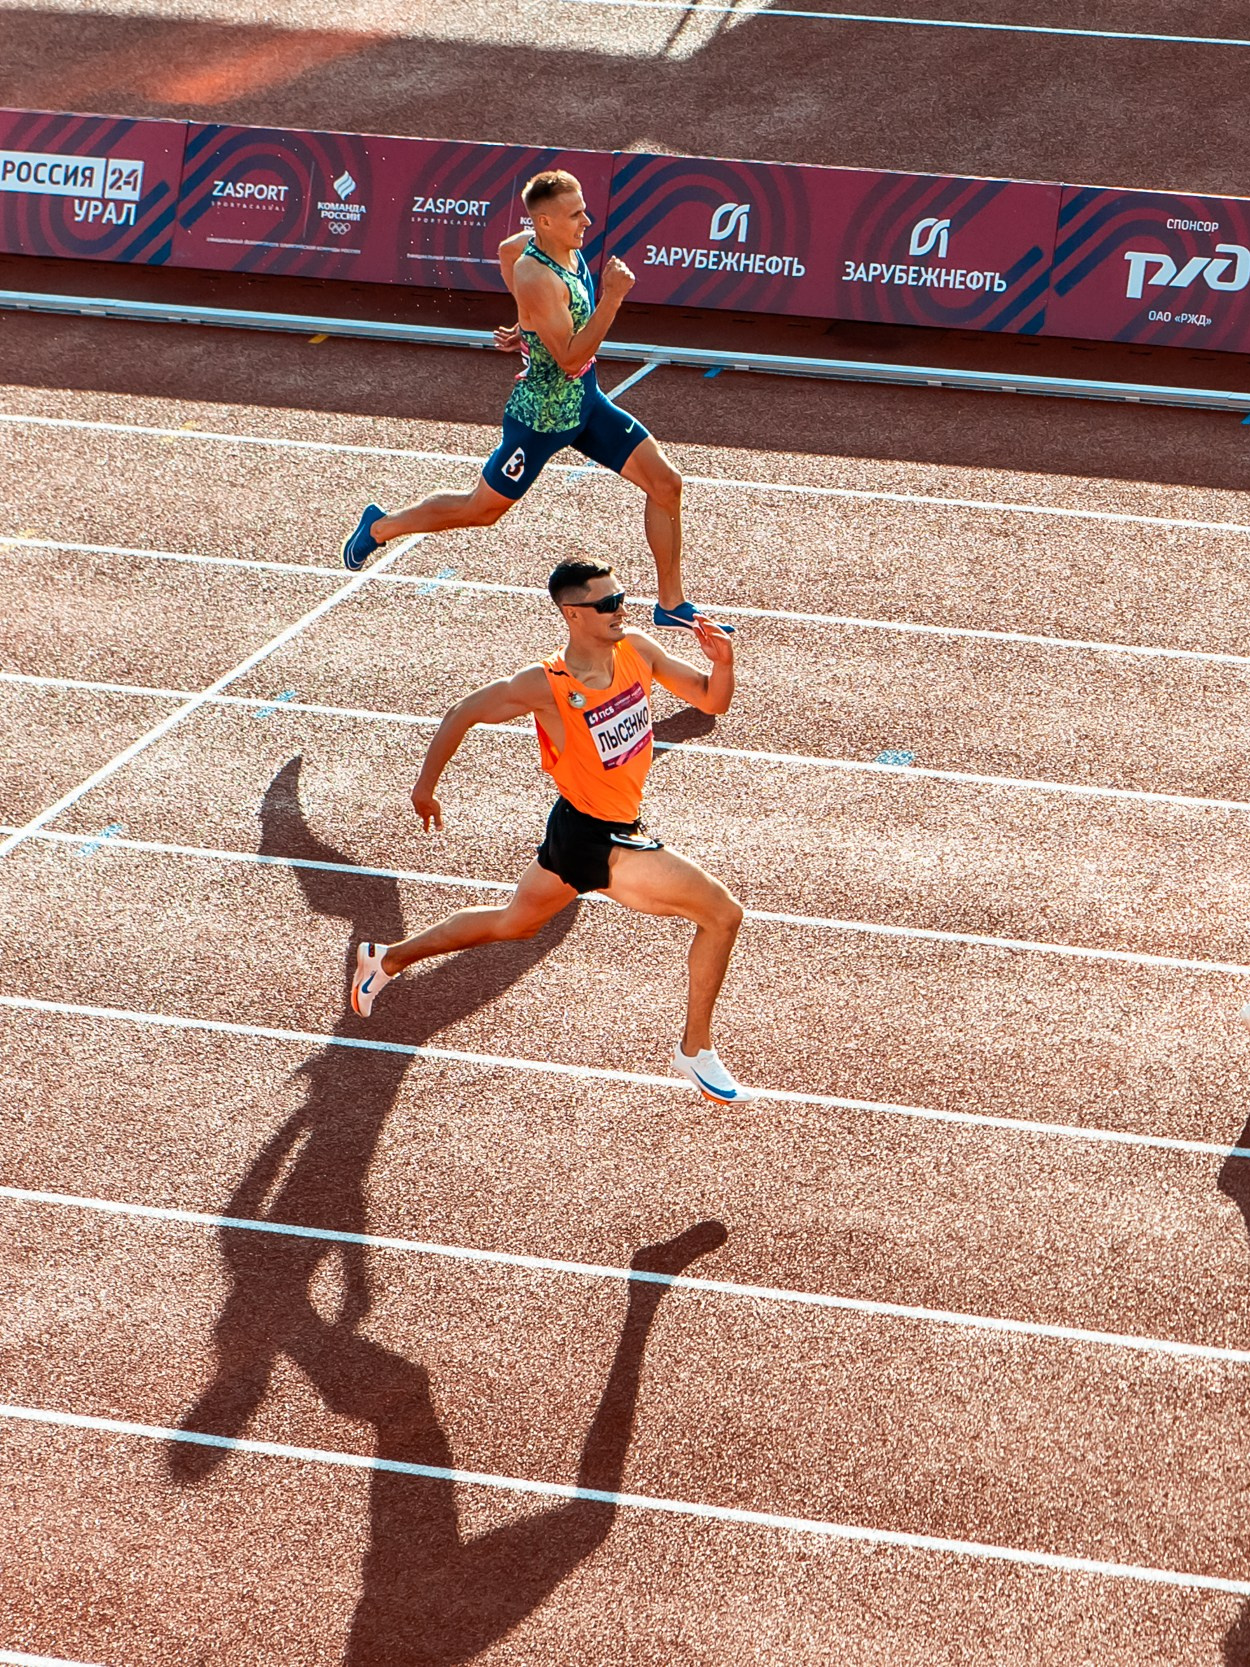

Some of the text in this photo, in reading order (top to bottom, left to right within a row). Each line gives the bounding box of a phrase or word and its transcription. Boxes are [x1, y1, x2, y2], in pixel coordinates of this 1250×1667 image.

[2, 160, 139, 191] РОССИЯ 24
[212, 180, 289, 201] ZASPORT
[74, 199, 137, 226] УРАЛ
[317, 201, 367, 214] КОМАНДА
[320, 211, 361, 221] РОССИИ
[412, 196, 490, 216] ZASPORT
[1166, 218, 1219, 233] СПОНСОР
[643, 244, 806, 278] ЗАРУБЕЖНЕФТЬ
[841, 260, 1007, 293] ЗАРУБЕЖНЕФТЬ
[1148, 310, 1212, 327] ОАО «РЖД»
[598, 706, 649, 753] ЛЫСЕНКО
